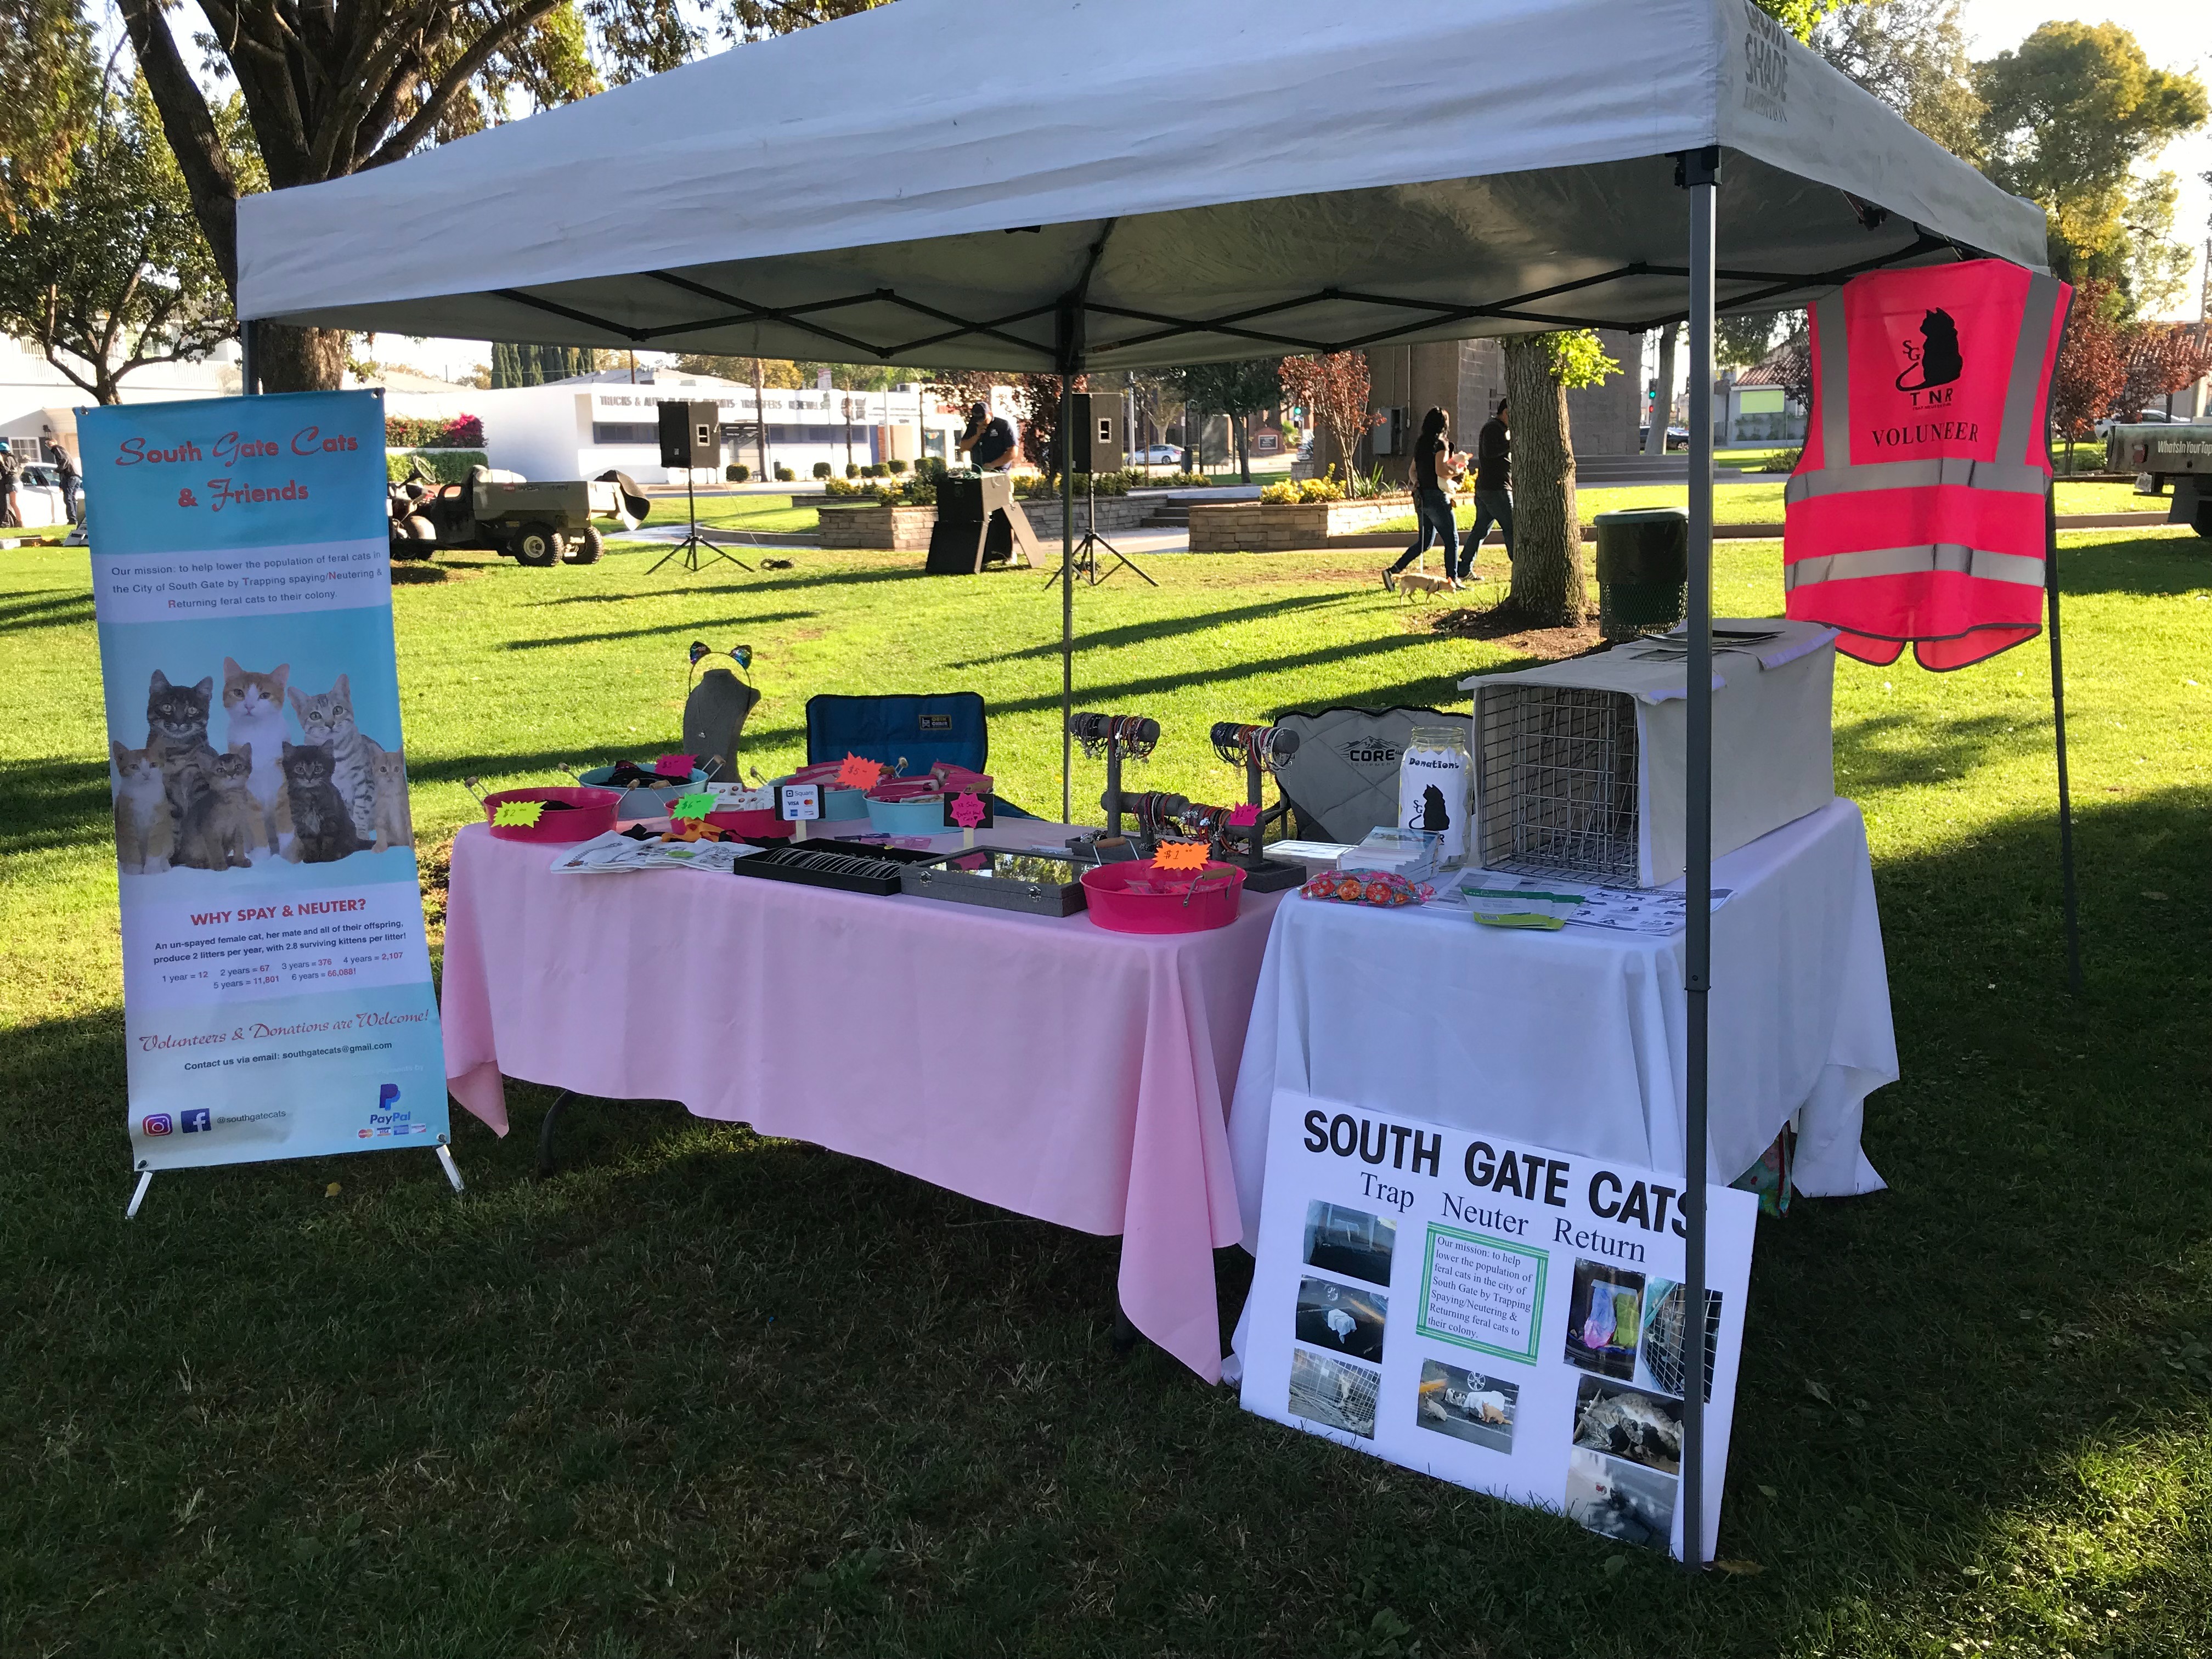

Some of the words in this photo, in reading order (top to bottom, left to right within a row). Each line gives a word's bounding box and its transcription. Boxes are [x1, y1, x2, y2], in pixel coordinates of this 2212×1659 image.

[1745, 33, 1788, 103] SHADE
[599, 396, 632, 406] TRUCKS
[635, 397, 641, 406] &
[741, 399, 782, 409] TRAFERS
[115, 437, 202, 466] South
[212, 431, 279, 467] Gate
[291, 425, 359, 456] Cats
[1871, 421, 1978, 448] VOLUNEER
[178, 488, 199, 507] &
[207, 477, 309, 512] Friends
[134, 566, 176, 574] mission:
[192, 563, 213, 572] help
[264, 557, 313, 569] population
[328, 554, 349, 562] feral
[133, 584, 152, 594] City
[156, 583, 165, 591] of
[168, 582, 198, 591] South
[200, 580, 224, 589] Gate
[228, 579, 239, 588] by
[242, 577, 285, 587] Trapping
[289, 569, 374, 585] spaying/Neutering
[168, 599, 217, 608] Returning
[221, 596, 242, 605] feral
[280, 592, 302, 601] their
[305, 591, 337, 600] colony.
[1350, 749, 1395, 761] CORE
[1408, 757, 1459, 769] Donations
[1164, 850, 1179, 859] $1
[190, 911, 232, 926] WHY
[238, 906, 276, 922] SPAY
[282, 905, 294, 917] &
[298, 898, 366, 915] NEUTER?
[154, 954, 191, 965] produce
[200, 950, 225, 958] litters
[244, 947, 264, 956] year,
[266, 944, 284, 952] with
[300, 938, 336, 949] surviving
[338, 936, 367, 945] kittens
[369, 935, 383, 944] per
[385, 933, 406, 941] litter!
[170, 938, 216, 949] un-spayed
[218, 935, 246, 944] female
[282, 929, 302, 938] mate
[303, 927, 318, 935] and
[343, 923, 362, 932] their
[364, 921, 404, 930] offspring,
[170, 974, 188, 983] year
[227, 968, 250, 977] years
[289, 961, 310, 970] years
[350, 955, 372, 964] years
[381, 952, 403, 961] 2,107
[221, 980, 244, 990] years
[253, 975, 279, 985] 11,801
[298, 972, 319, 981] years
[328, 968, 356, 977] 66,088!
[139, 1032, 226, 1052] Volunteers
[232, 1027, 245, 1041] &
[249, 1021, 330, 1039] Donations
[332, 1019, 353, 1030] are
[356, 1009, 429, 1028] Welcome!
[184, 1059, 221, 1071] Contact
[223, 1057, 234, 1065] us
[236, 1056, 250, 1064] via
[252, 1052, 280, 1063] email:
[282, 1041, 393, 1060] southgatecats@gmail.com
[217, 1109, 286, 1125] @southgatecats
[370, 1111, 411, 1125] PayPal
[1304, 1109, 1442, 1178] SOUTH
[1463, 1139, 1570, 1208] GATE
[1361, 1171, 1414, 1214] Trap
[1442, 1192, 1529, 1237] Neuter
[1552, 1216, 1646, 1265] Return
[1436, 1249, 1459, 1263] lower
[1461, 1257, 1474, 1267] the
[1475, 1262, 1520, 1280] population
[1522, 1274, 1533, 1283] of
[1437, 1236, 1453, 1248] Our
[1455, 1242, 1490, 1257] mission:
[1492, 1251, 1500, 1260] to
[1503, 1253, 1521, 1267] help
[1435, 1263, 1453, 1276] feral
[1455, 1270, 1471, 1280] cats
[1474, 1273, 1481, 1283] in
[1483, 1277, 1497, 1287] the
[1498, 1281, 1514, 1294] city
[1516, 1286, 1527, 1295] of
[1431, 1289, 1508, 1321] Spaying/Neutering
[1509, 1312, 1517, 1322] &
[1432, 1276, 1456, 1290] South
[1458, 1283, 1478, 1296] Gate
[1480, 1289, 1491, 1301] by
[1493, 1293, 1531, 1313] Trapping
[1428, 1317, 1447, 1329] their
[1448, 1323, 1479, 1339] colony.
[1429, 1303, 1470, 1324] Returning
[1472, 1315, 1491, 1328] feral
[1493, 1322, 1509, 1333] cats
[1511, 1327, 1520, 1336] to
